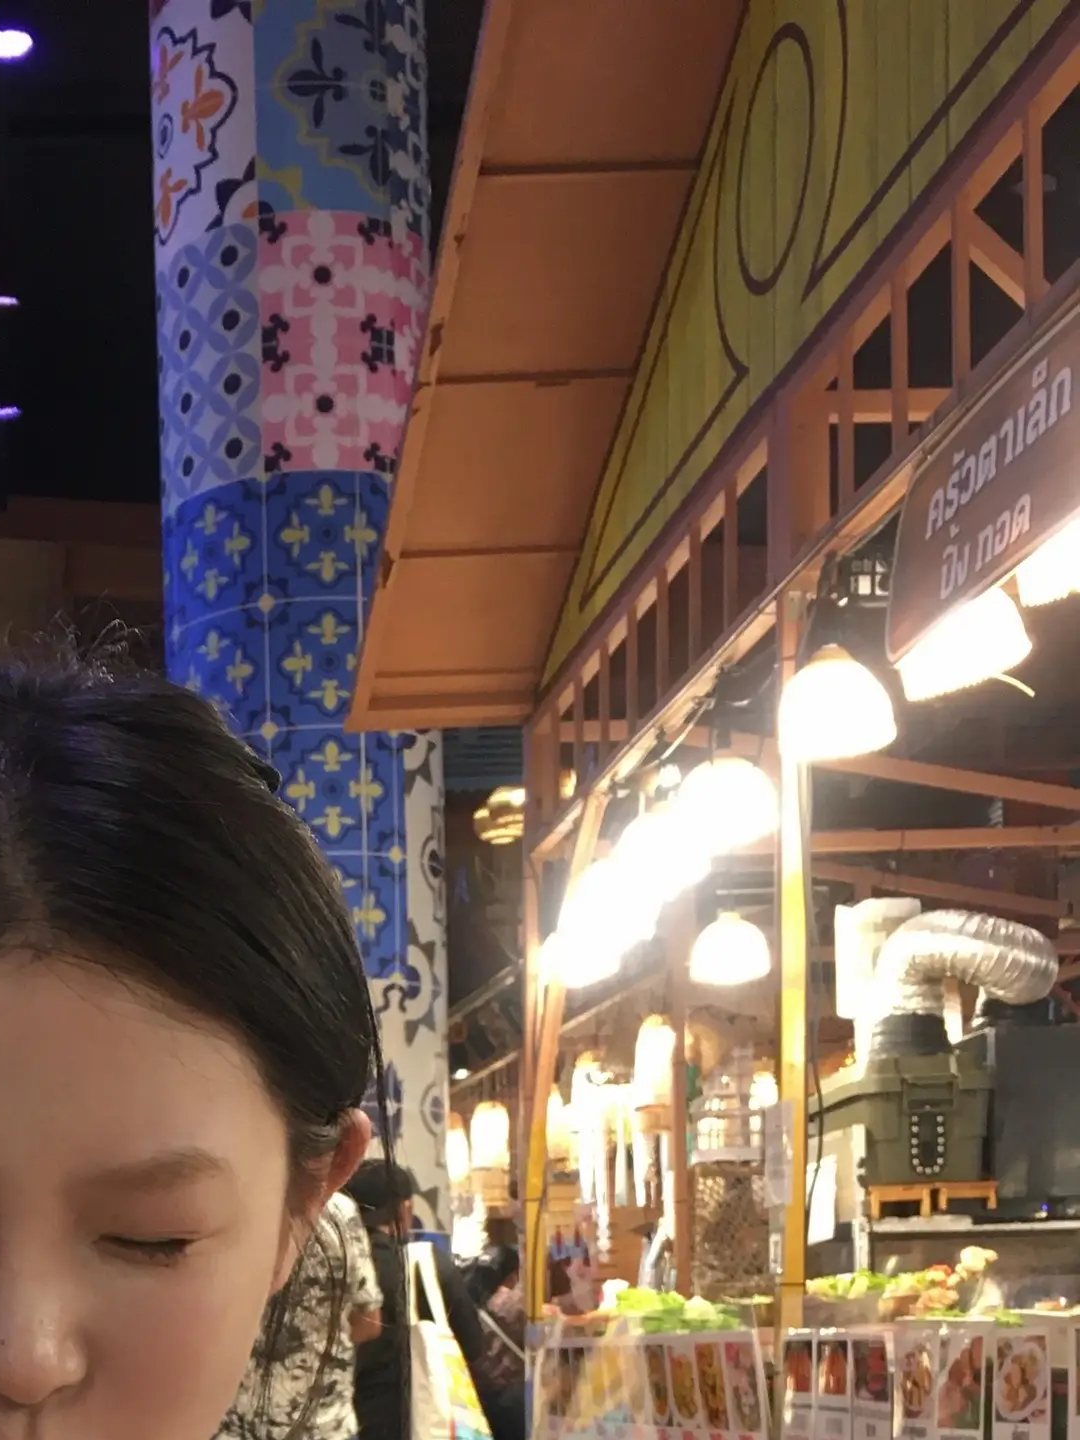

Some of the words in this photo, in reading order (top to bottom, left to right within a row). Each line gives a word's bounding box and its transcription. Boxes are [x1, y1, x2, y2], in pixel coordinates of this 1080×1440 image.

[925, 357, 1073, 541] ครัวตาเล็ก
[974, 493, 1031, 572] ทอด
